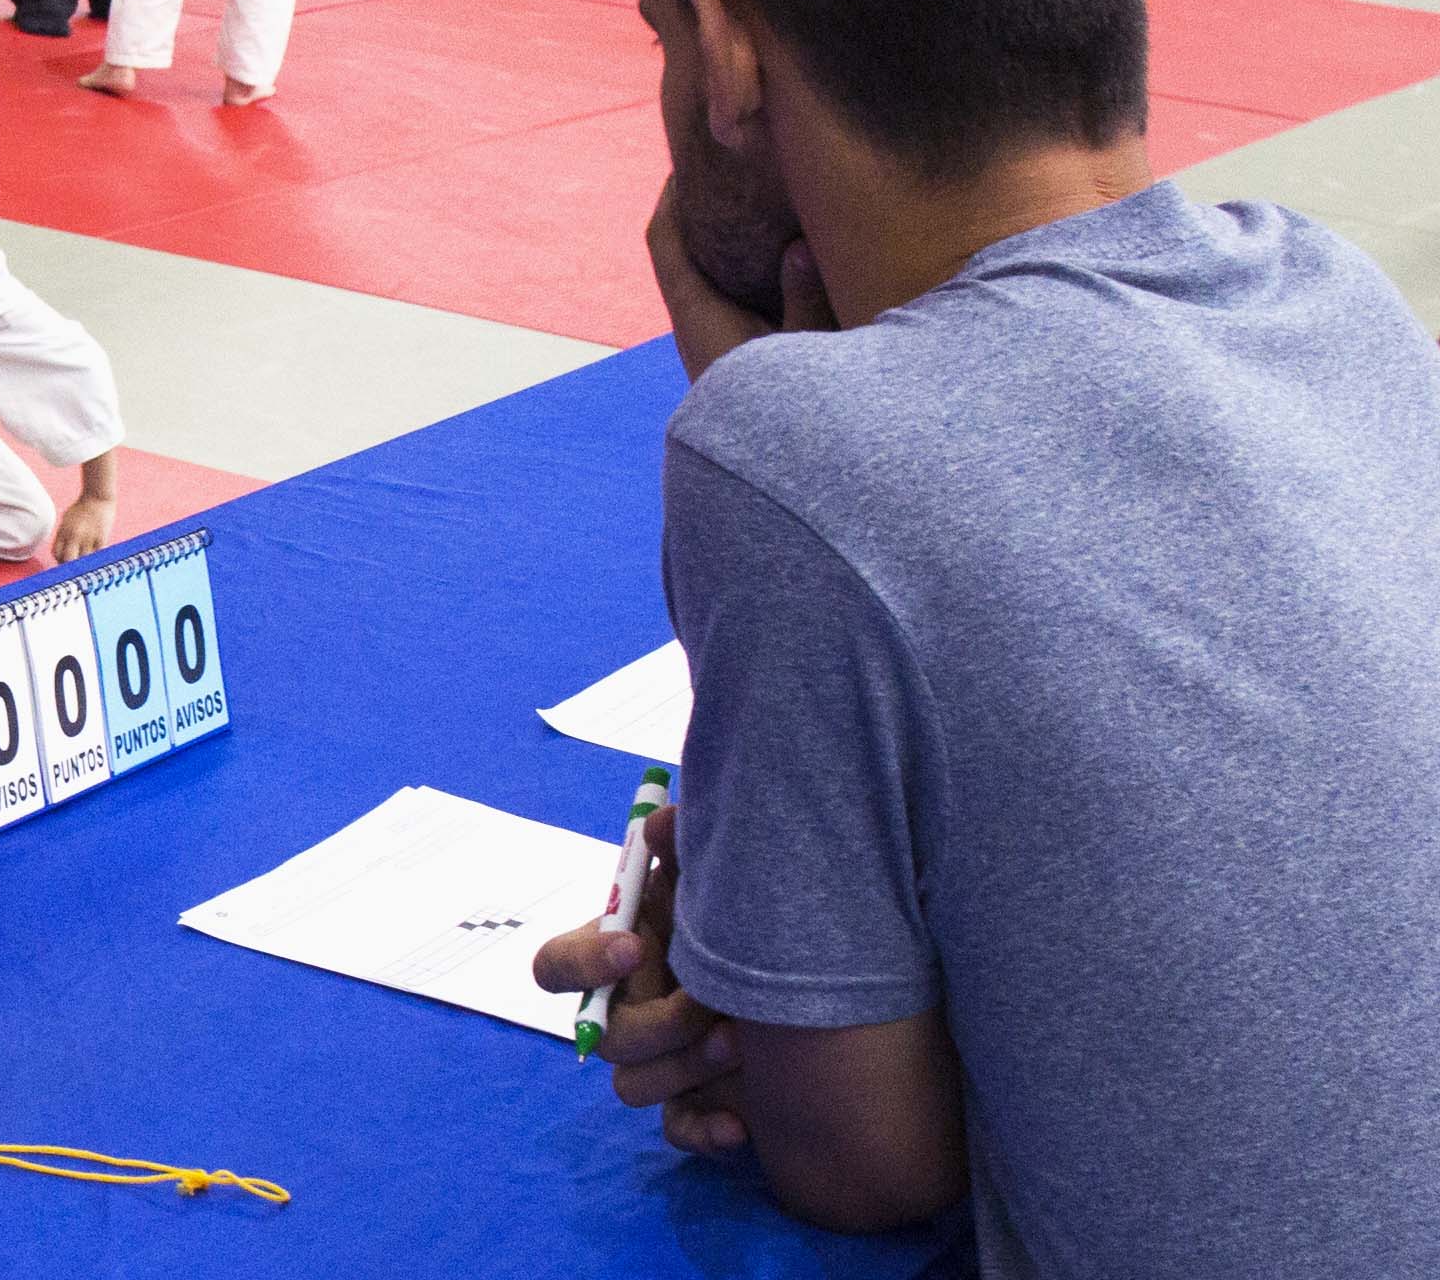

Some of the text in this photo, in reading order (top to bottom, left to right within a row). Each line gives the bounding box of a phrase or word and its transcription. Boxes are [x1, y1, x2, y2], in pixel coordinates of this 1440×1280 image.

[54, 654, 87, 738] 0
[116, 628, 151, 710] 0
[174, 604, 206, 684] 0
[53, 744, 104, 788] PUNTOS
[115, 715, 166, 759] PUNTOS
[175, 690, 224, 733] AVISOS
